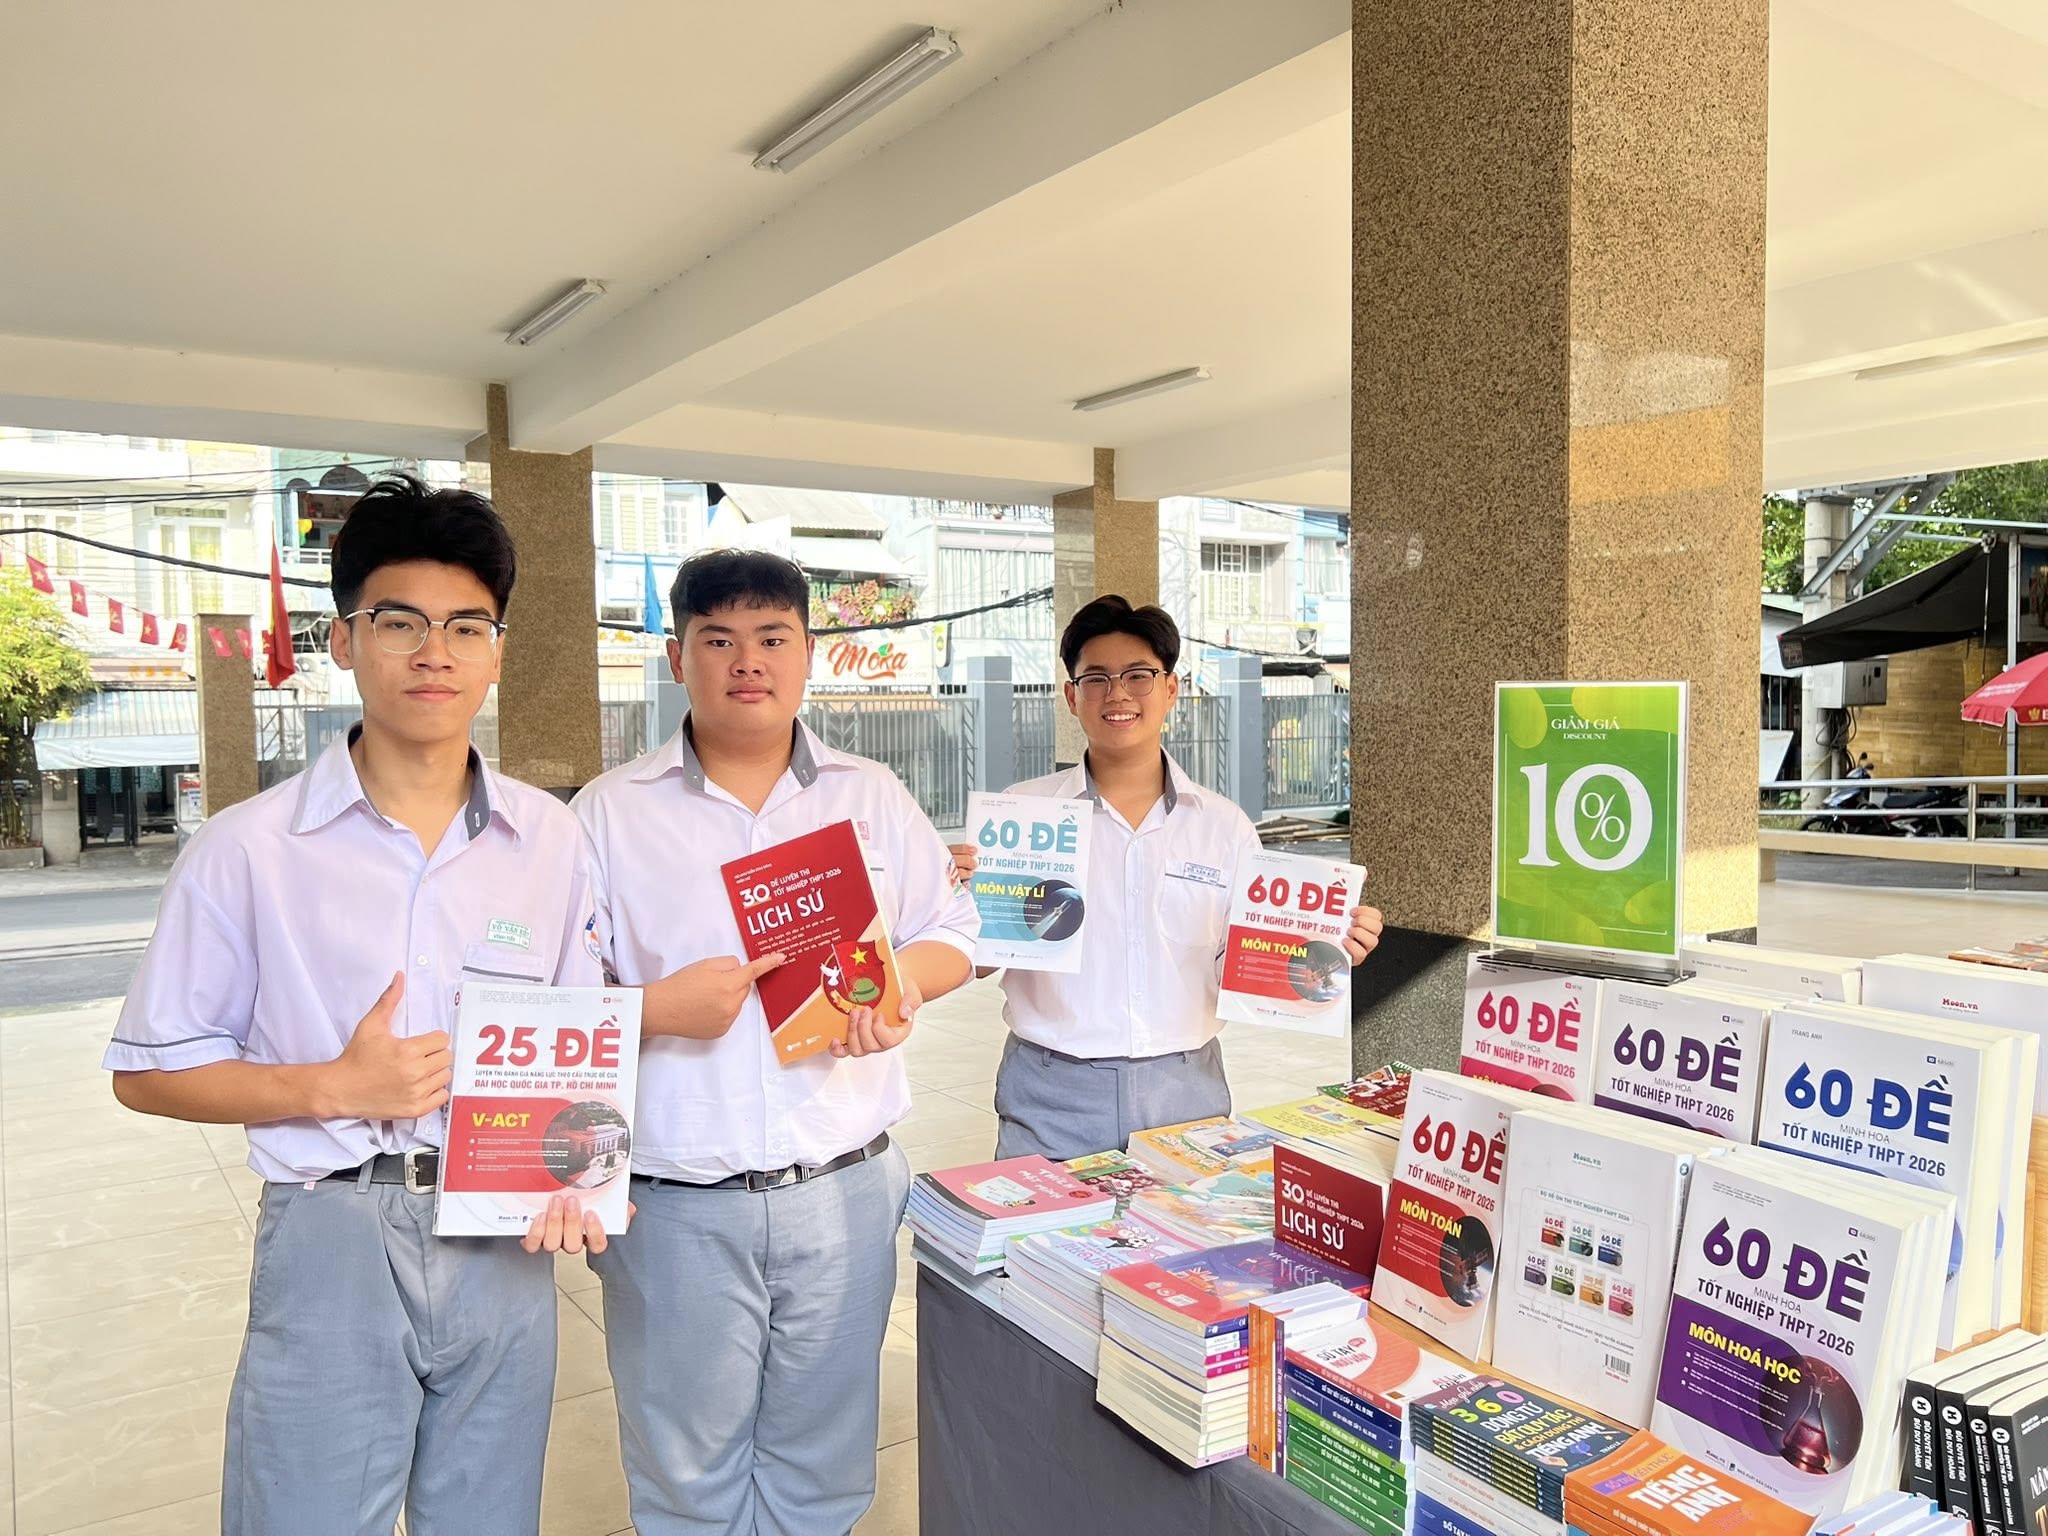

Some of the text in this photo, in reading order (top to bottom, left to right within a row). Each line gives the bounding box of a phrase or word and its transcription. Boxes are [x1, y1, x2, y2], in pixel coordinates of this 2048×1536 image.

[827, 640, 908, 680] Moka
[1551, 715, 1621, 730] GIẢM GIÁ
[1563, 732, 1608, 741] DISCOUNT
[978, 814, 1078, 854] 60 ĐỀ
[1518, 763, 1653, 872] 10
[1580, 792, 1625, 843] %
[809, 872, 825, 885] THPT
[825, 867, 842, 879] 2026
[977, 855, 1075, 873] TỐT NGHIỆP THPT 2026
[739, 883, 771, 908] 30
[799, 867, 810, 879] THI
[975, 881, 1045, 899] MÔN VẬT LÍ
[1247, 874, 1348, 917] 60 ĐỀ
[746, 887, 825, 936] LỊCH SỬ
[1245, 910, 1341, 936] TỐT NGHIỆP THPT 2026
[1241, 936, 1308, 959] MÔN TOÁN
[1477, 990, 1581, 1052] 60 ĐỀ
[1942, 998, 1979, 1011] Moon.vn
[475, 1015, 622, 1068] 25 ĐỀ
[1792, 1028, 1823, 1040] TRANG ANH
[1475, 1039, 1576, 1079] TỐT NGHIỆP THPT 2026
[1614, 1022, 1742, 1093] 60 ĐỀ
[510, 1079, 532, 1089] QUỐC
[534, 1080, 548, 1089] GIA
[551, 1081, 564, 1090] TP.
[566, 1079, 578, 1090] HỒ
[580, 1079, 593, 1090] CHÍ
[596, 1081, 617, 1090] MINH
[1611, 1076, 1735, 1122] TỐT NGHIỆP THPT 2026
[1654, 1077, 1673, 1089] MINH
[1784, 1061, 1953, 1144] 60 ĐỀ
[472, 1112, 530, 1128] V-ACT
[1839, 1124, 1866, 1139] MINH
[1412, 1114, 1507, 1185] 60 ĐỀ
[1782, 1122, 1946, 1177] TỐT NGHIỆP THPT 2026
[1281, 1178, 1305, 1204] 30
[1408, 1162, 1495, 1212] TỐT NGHIỆP THPT 2026
[1281, 1204, 1345, 1250] LỊCH SỬ
[1336, 1212, 1350, 1224] THPT
[1350, 1218, 1365, 1230] 2026
[1399, 1198, 1463, 1240] MÔN TOÁN
[1702, 1216, 1871, 1323] 60 ĐỀ
[1753, 1286, 1778, 1303] MINH
[1697, 1276, 1855, 1357] TỐT NGHIỆP THPT 2026
[1688, 1321, 1802, 1384] MÔN HOÁ HỌC
[1516, 1416, 1549, 1438] QUY
[1524, 1421, 1606, 1458] TIẾNG ANH
[1626, 1464, 1718, 1510] TIẾNG
[1671, 1484, 1743, 1524] ANH
